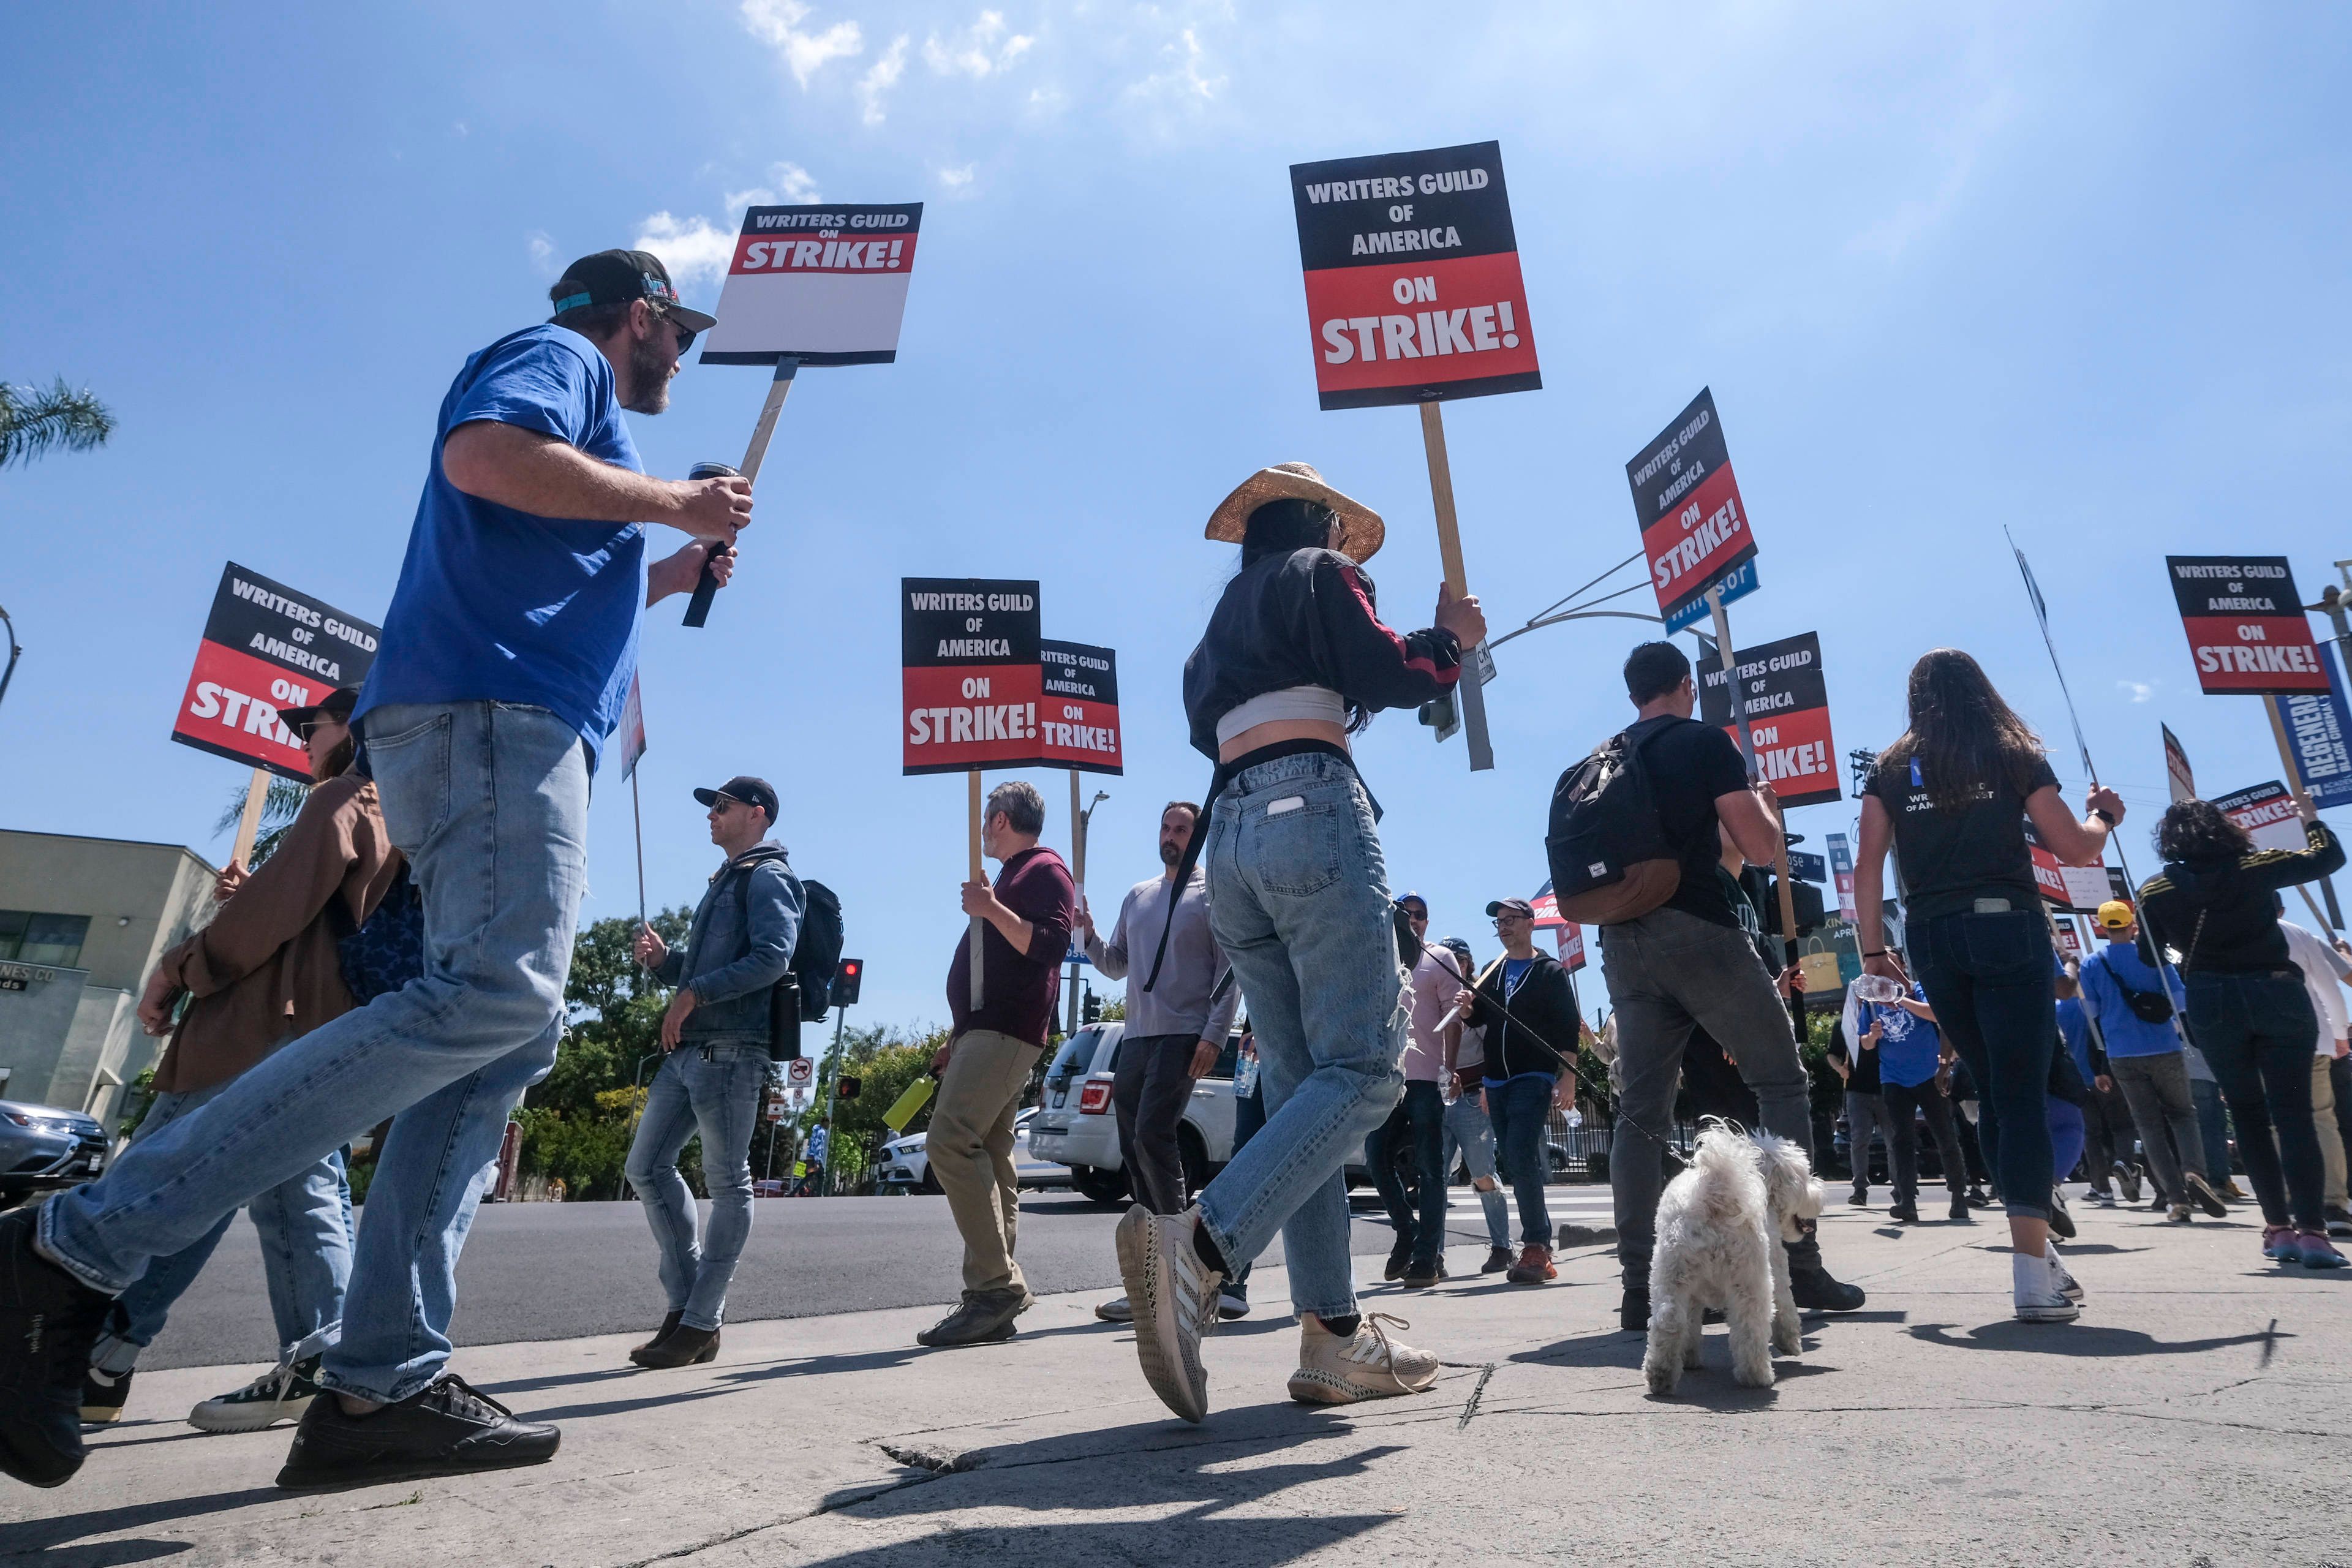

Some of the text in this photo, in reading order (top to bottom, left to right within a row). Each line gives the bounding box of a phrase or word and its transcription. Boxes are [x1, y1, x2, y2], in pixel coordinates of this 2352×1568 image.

[1305, 168, 1488, 204] WRITERS GUILD
[756, 214, 909, 228] WRITERS GUILD
[1389, 204, 1414, 223] OF
[819, 229, 839, 239] ON
[1351, 226, 1462, 255] AMERICA
[742, 239, 903, 270] STRIKE!
[1393, 276, 1437, 304] ON
[1322, 301, 1520, 364] STRIKE!
[1634, 410, 1709, 487] WRITERS GUILD
[1670, 457, 1681, 475] OF
[1659, 460, 1705, 510] AMERICA
[1681, 501, 1701, 530] ON
[1654, 497, 1741, 589] STRIKE!
[2175, 565, 2287, 579] WRITERS GUILD
[2228, 582, 2244, 594] OF
[910, 592, 1033, 611] WRITERS GUILD
[2208, 597, 2277, 611] AMERICA
[232, 578, 378, 653] WRITERS GUILD
[965, 617, 982, 633] OF
[292, 627, 314, 645] OF
[2237, 625, 2266, 641] ON
[249, 632, 340, 681] AMERICA
[937, 639, 1011, 657] AMERICA
[1041, 650, 1109, 671] RITERS GUILD
[1705, 650, 1812, 687] WRTERS GUILD
[2197, 645, 2320, 674] STRIKE!
[1064, 668, 1076, 678] OF
[271, 678, 309, 707] ON
[962, 677, 990, 698] ON
[1045, 679, 1096, 696] AMERICA
[1751, 679, 1766, 693] OF
[190, 681, 304, 750] STRI
[1063, 705, 1083, 720] ON
[910, 703, 1036, 745] STRIKE!
[1042, 721, 1116, 753] TRIKE!
[1752, 726, 1779, 747] ON
[2286, 695, 2339, 778] REGENERA
[1756, 740, 1828, 782] RIKE!
[2332, 741, 2352, 773] BLACK
[2215, 786, 2281, 810] RITERS GUILD
[1787, 855, 1804, 867] ose
[1825, 917, 1842, 929] KIN
[1066, 949, 1085, 958] ose
[1559, 935, 1581, 963] STRIKE!
[0, 964, 29, 979] NES
[2, 980, 20, 989] ds
